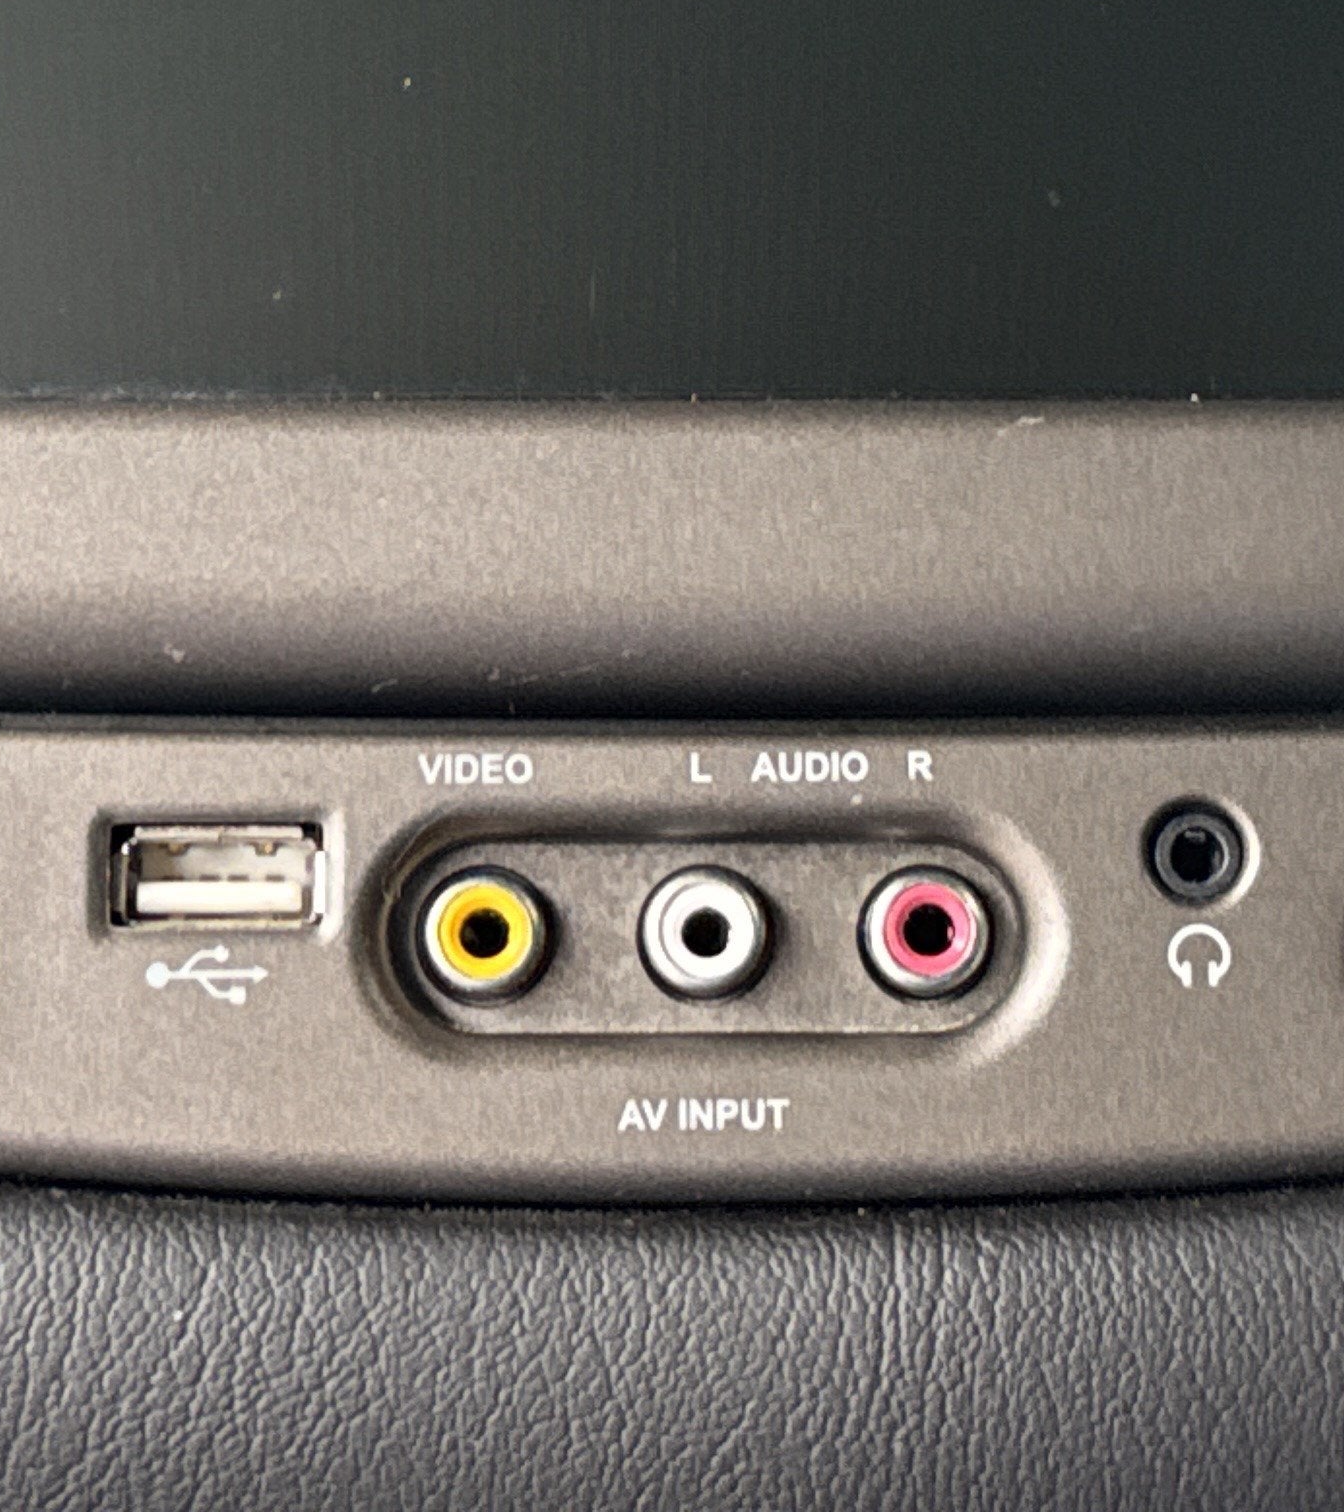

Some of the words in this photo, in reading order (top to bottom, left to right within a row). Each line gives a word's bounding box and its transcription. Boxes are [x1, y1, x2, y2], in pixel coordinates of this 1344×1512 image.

[418, 753, 533, 785] VIDEO
[690, 752, 713, 784] L
[751, 750, 869, 783] AUDIO
[907, 749, 934, 781] R
[617, 1098, 667, 1131] AV
[678, 1098, 791, 1131] INPUT
